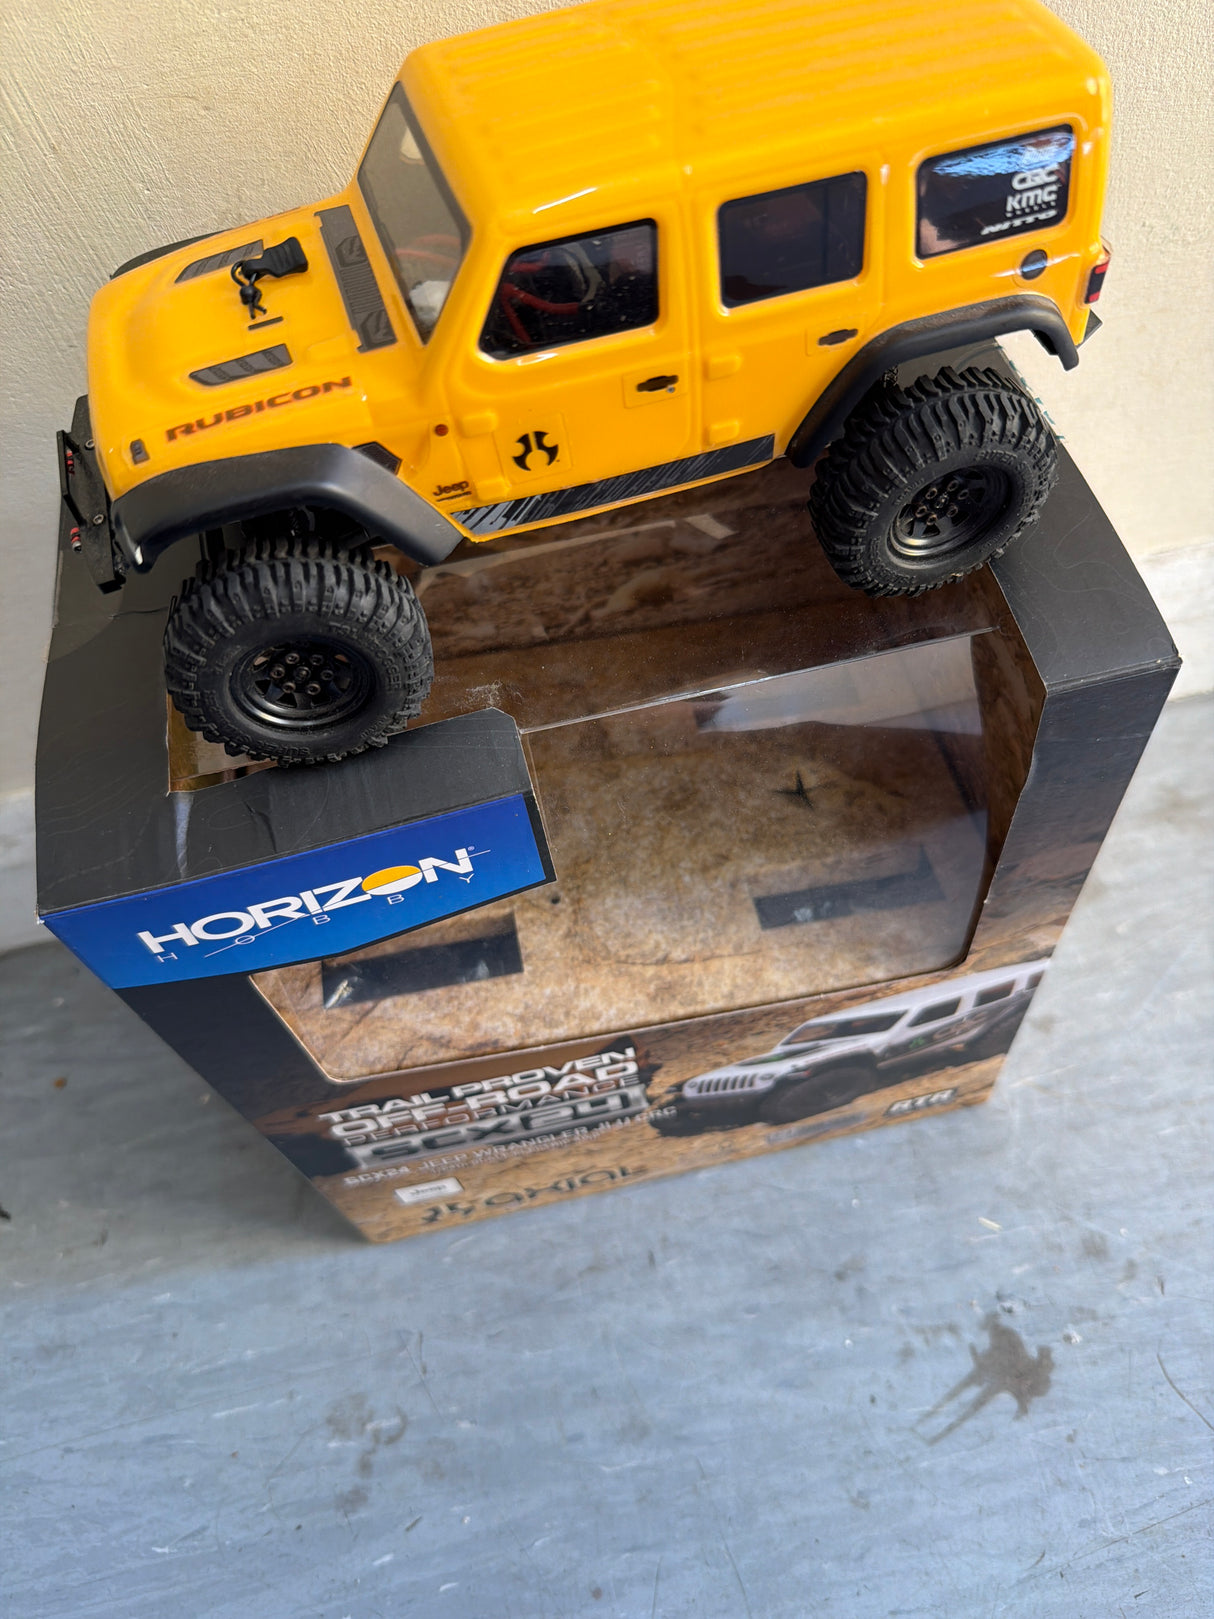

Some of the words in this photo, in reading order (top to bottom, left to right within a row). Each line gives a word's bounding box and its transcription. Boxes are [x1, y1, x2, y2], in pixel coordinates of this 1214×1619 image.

[1006, 184, 1059, 212] KMC
[166, 376, 353, 442] RUBICON
[433, 480, 469, 497] Jeep
[137, 847, 475, 954] HORIZON
[157, 873, 475, 963] HOBBY
[318, 1092, 450, 1122] TRAIL
[451, 1047, 636, 1098] PROVEN
[331, 1061, 639, 1138] OFF-ROAD
[343, 1074, 641, 1147] PERFORMANCE
[343, 1165, 411, 1187] SCX24
[418, 1153, 468, 1171] JEEP
